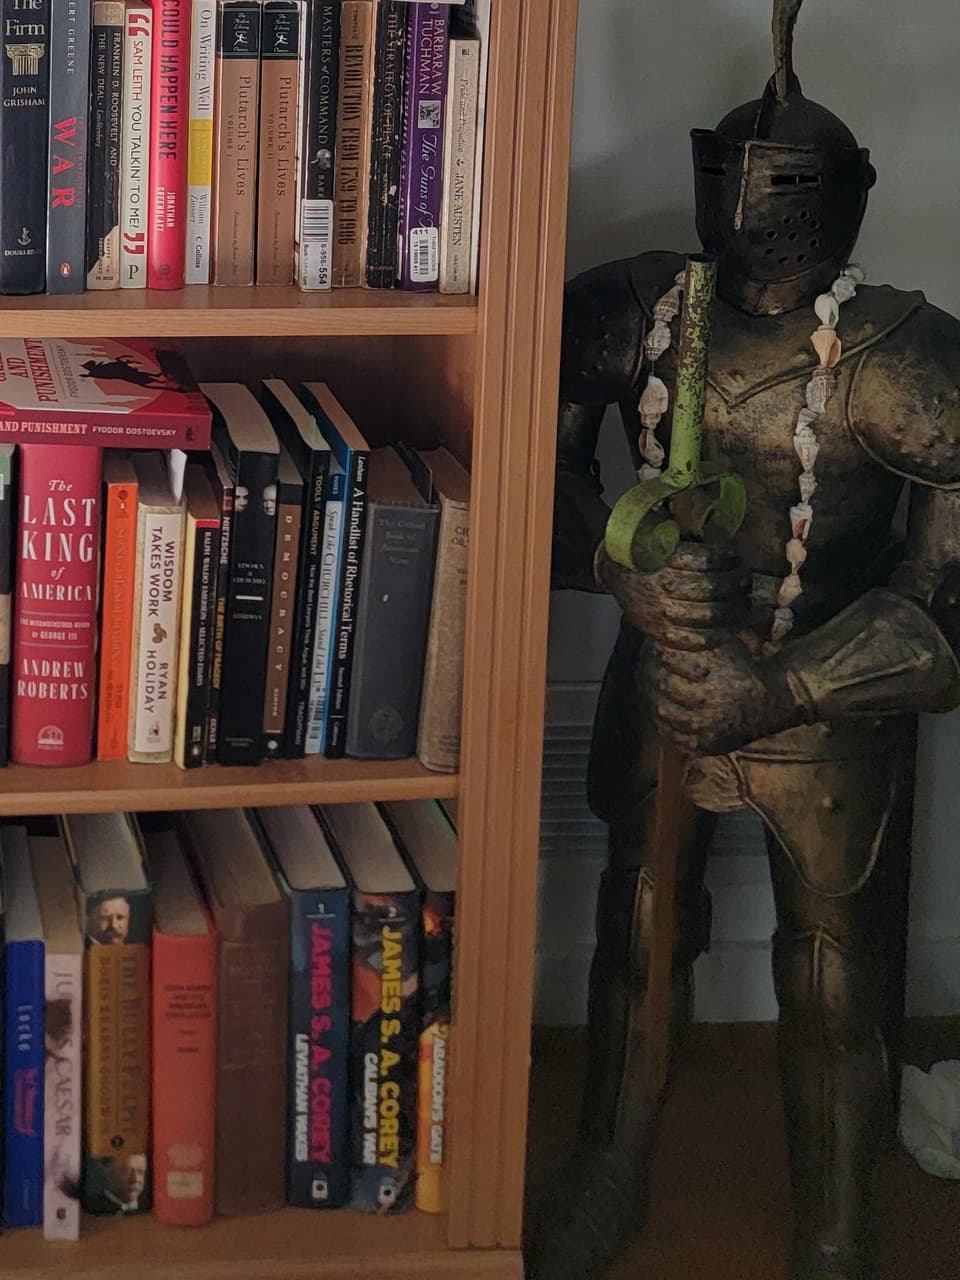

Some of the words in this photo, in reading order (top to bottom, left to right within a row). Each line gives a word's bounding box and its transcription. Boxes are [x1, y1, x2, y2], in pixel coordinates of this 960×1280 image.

[4, 20, 46, 37] Firm
[159, 0, 182, 49] COULD
[198, 9, 214, 30] On
[66, 27, 77, 75] GREENE
[131, 39, 144, 65] SAM
[193, 33, 213, 81] Writing
[418, 19, 432, 95] TUCHMAN
[431, 19, 446, 74] BARBARA
[12, 87, 38, 95] JOHN
[130, 67, 144, 101] LEITH
[158, 54, 180, 114] HAPPEN
[197, 85, 211, 112] Well
[430, 75, 441, 96] W.
[3, 97, 46, 107] GRISHAM
[130, 103, 143, 131] YOU
[236, 75, 251, 152] Plutarch's
[158, 119, 178, 162] HERE
[53, 116, 76, 209] WAR
[129, 135, 143, 183] TALKIN'
[235, 157, 249, 197] Lives
[129, 185, 142, 203] TO
[128, 207, 142, 229] ME?
[20, 422, 88, 435] PUNISHMENT
[48, 479, 73, 492] The
[23, 494, 96, 527] LAST
[21, 530, 94, 563] KING
[151, 526, 164, 571] TAKES
[50, 567, 65, 580] of
[161, 540, 176, 603] WISDOM
[20, 582, 93, 602] AMERICA
[147, 573, 162, 618] WORK
[21, 658, 87, 678] ANDREW
[144, 649, 159, 714] HOLIDAY
[157, 661, 170, 701] RYAN
[16, 680, 89, 700] ROBERTS
[381, 926, 403, 1014] JAMES
[381, 1019, 401, 1043] S.
[380, 1049, 401, 1076] A.
[379, 1081, 400, 1168] COREY
